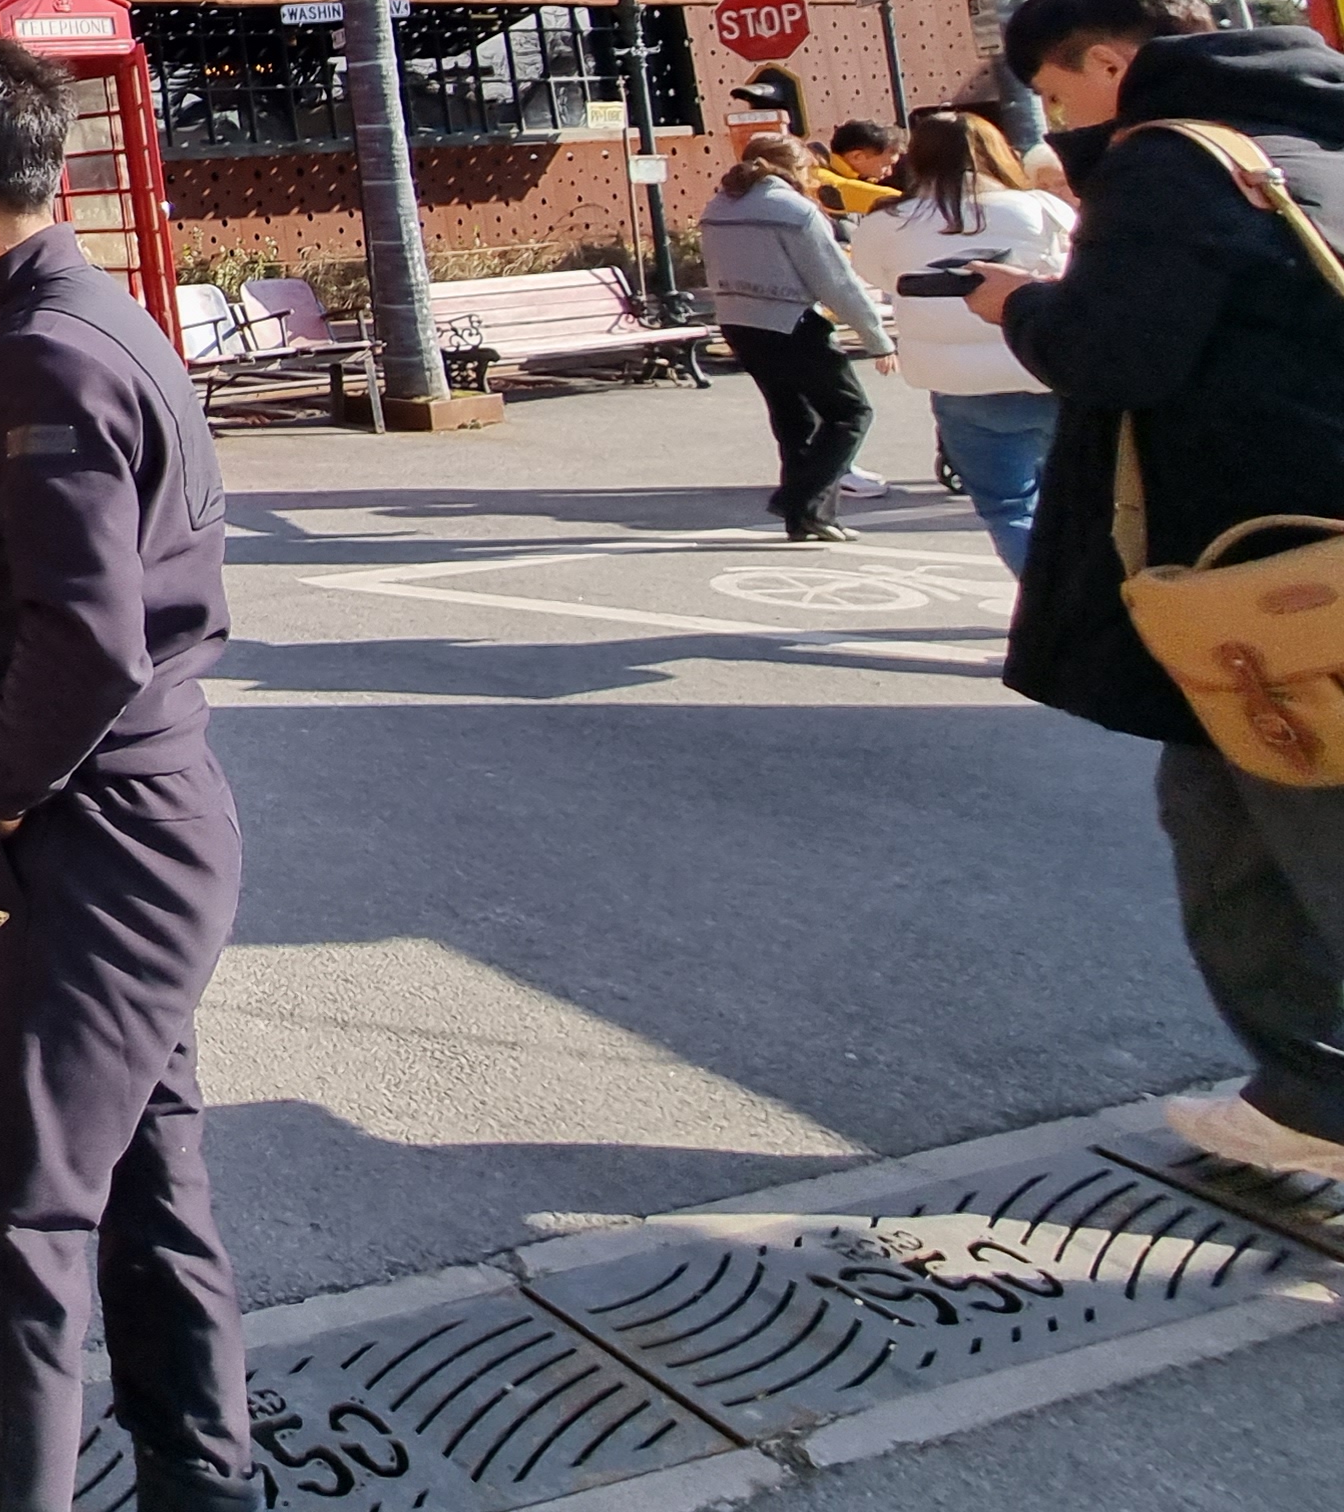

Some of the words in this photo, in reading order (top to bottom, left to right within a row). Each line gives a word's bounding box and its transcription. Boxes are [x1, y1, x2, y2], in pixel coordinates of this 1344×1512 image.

[287, 6, 342, 20] WASHIN
[721, 3, 802, 40] STOP
[20, 18, 110, 35] TELEPHONE
